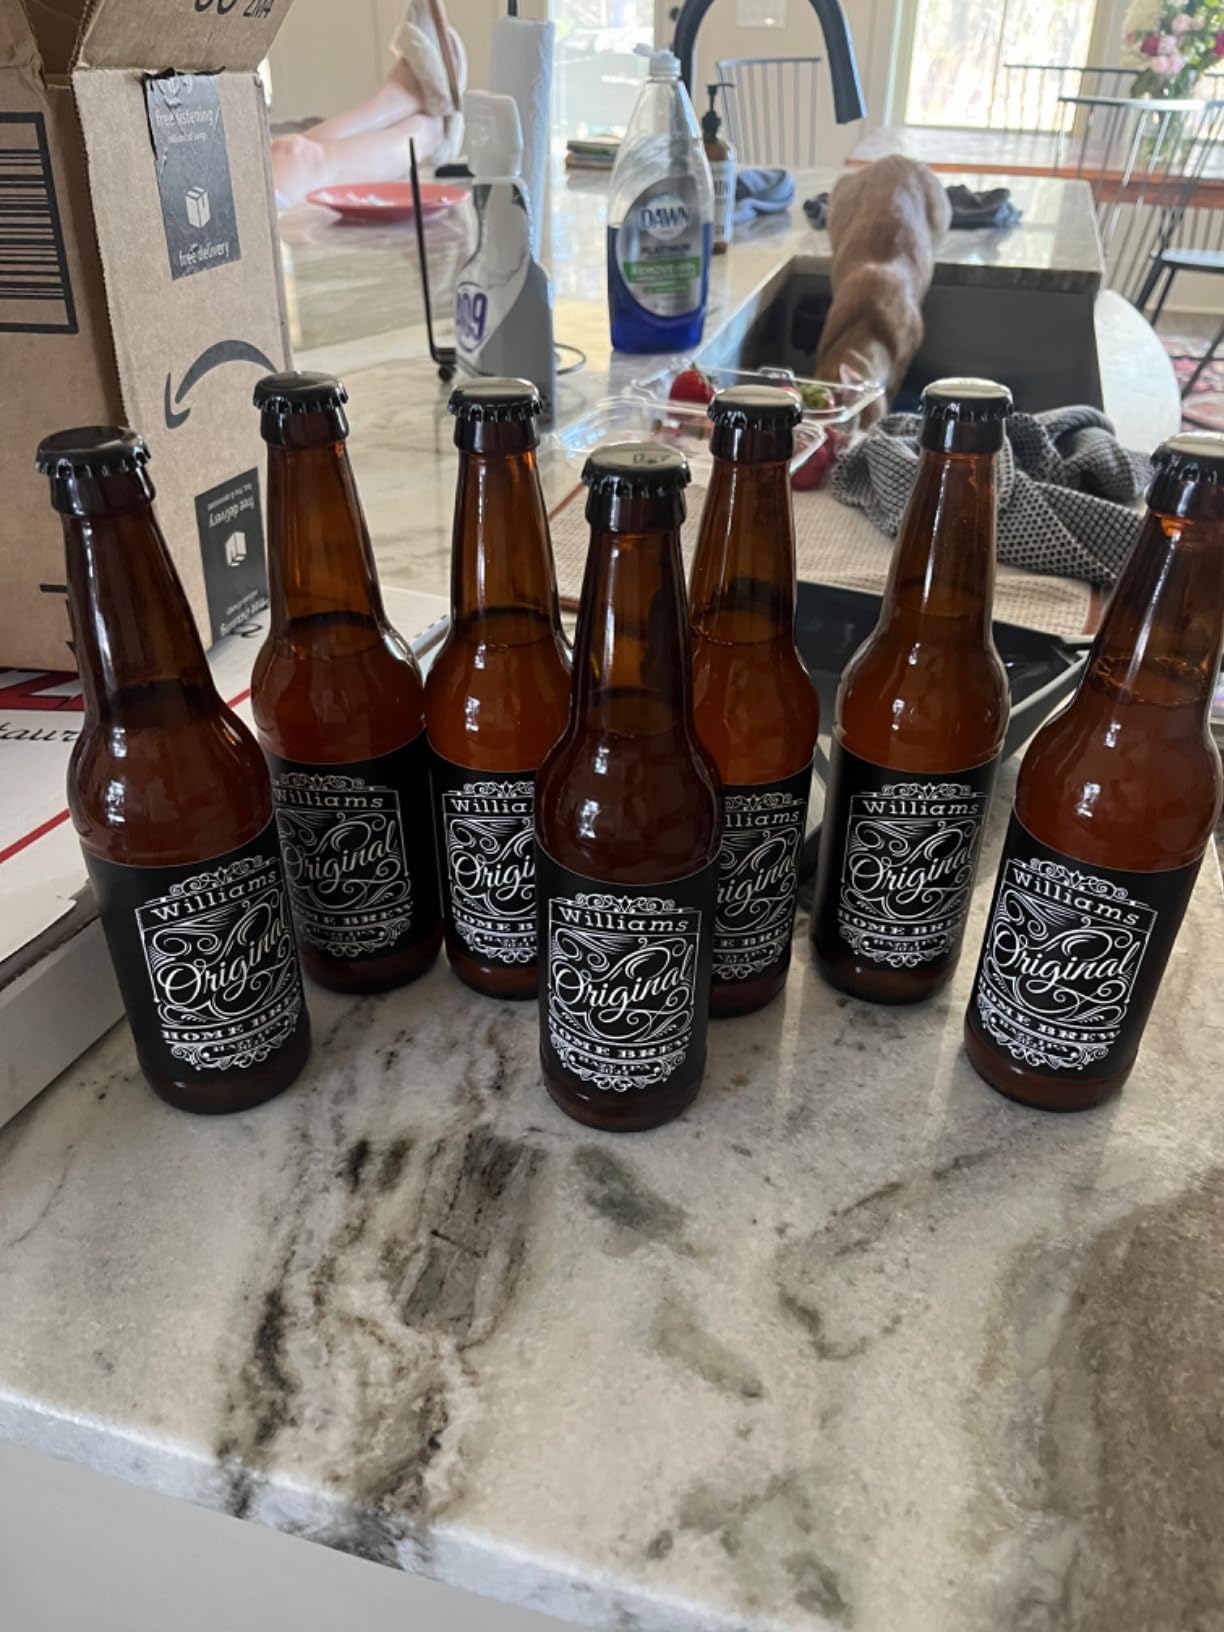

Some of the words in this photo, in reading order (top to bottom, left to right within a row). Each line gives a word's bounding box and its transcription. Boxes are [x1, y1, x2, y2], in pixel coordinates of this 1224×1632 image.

[273, 787, 384, 808] Williams
[450, 798, 535, 814] Willia
[725, 811, 800, 828] lliams
[862, 799, 980, 816] Williams
[280, 820, 397, 895] Original
[451, 850, 535, 901] Origi
[849, 826, 980, 905] Original
[151, 869, 277, 921] Williams
[559, 906, 689, 932] Williams
[1013, 868, 1141, 925] Williams
[156, 892, 289, 1005] Original
[993, 920, 1142, 994] Original
[552, 943, 694, 1023] Original
